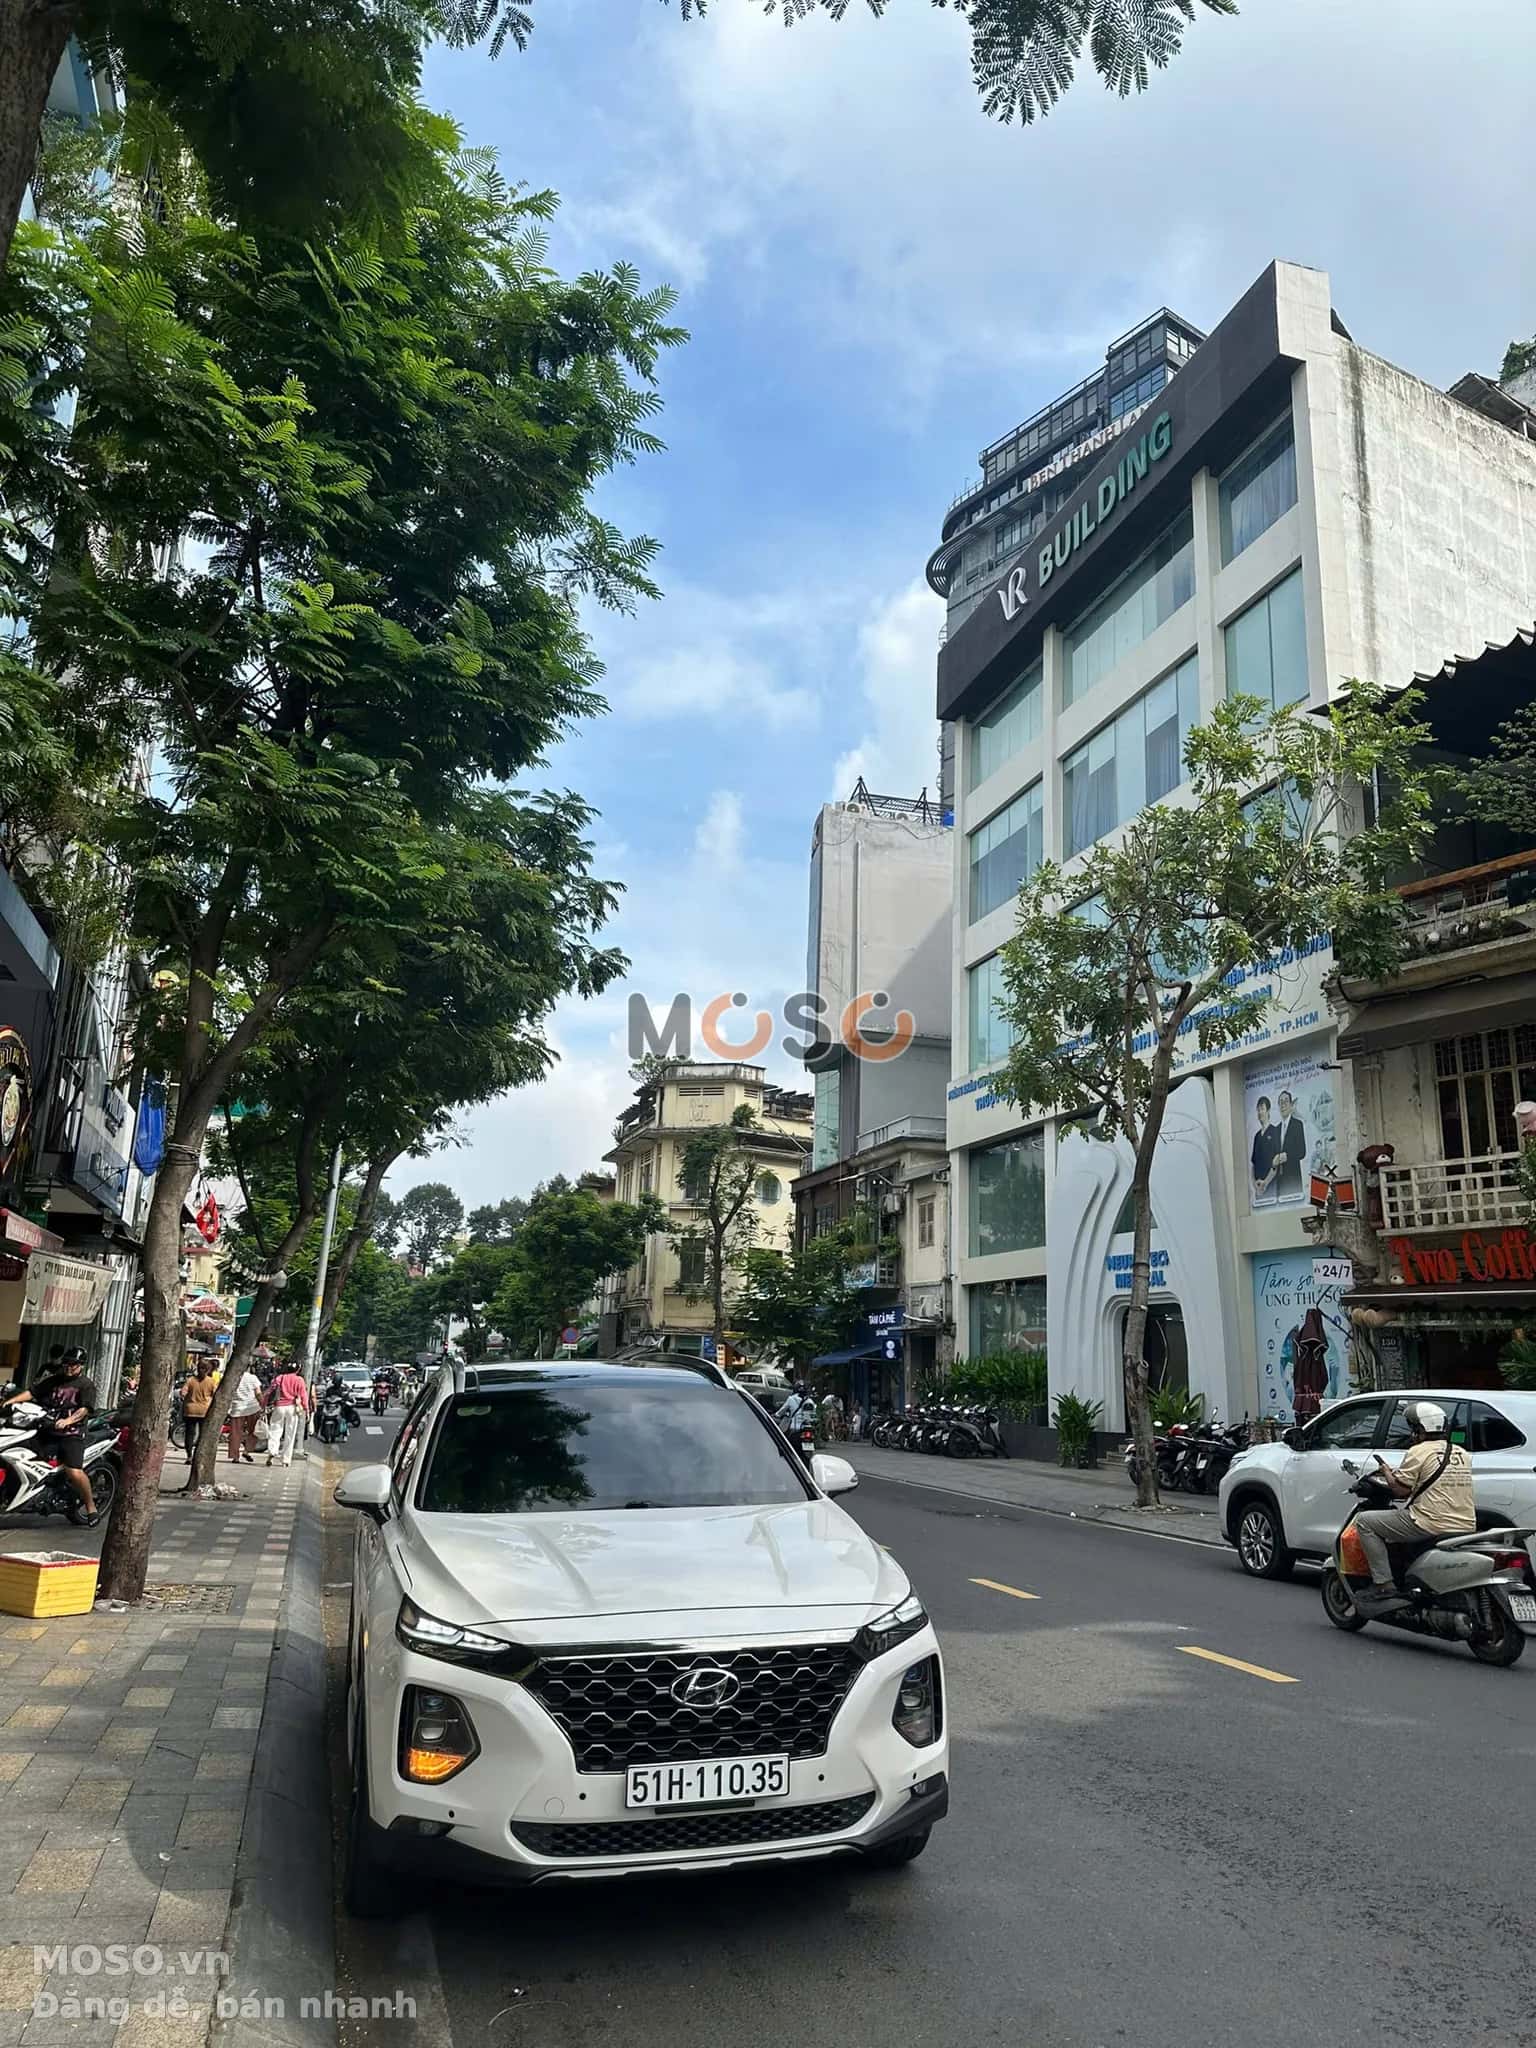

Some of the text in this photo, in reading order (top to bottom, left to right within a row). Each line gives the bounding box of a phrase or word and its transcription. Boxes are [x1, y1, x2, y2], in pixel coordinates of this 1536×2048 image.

[1038, 410, 1173, 588] BUILDING
[1279, 1011, 1319, 1034] TP.HCM
[1322, 1263, 1350, 1278] 24/7
[1388, 1236, 1457, 1286] Two
[632, 1760, 784, 1803] 51H-110.35
